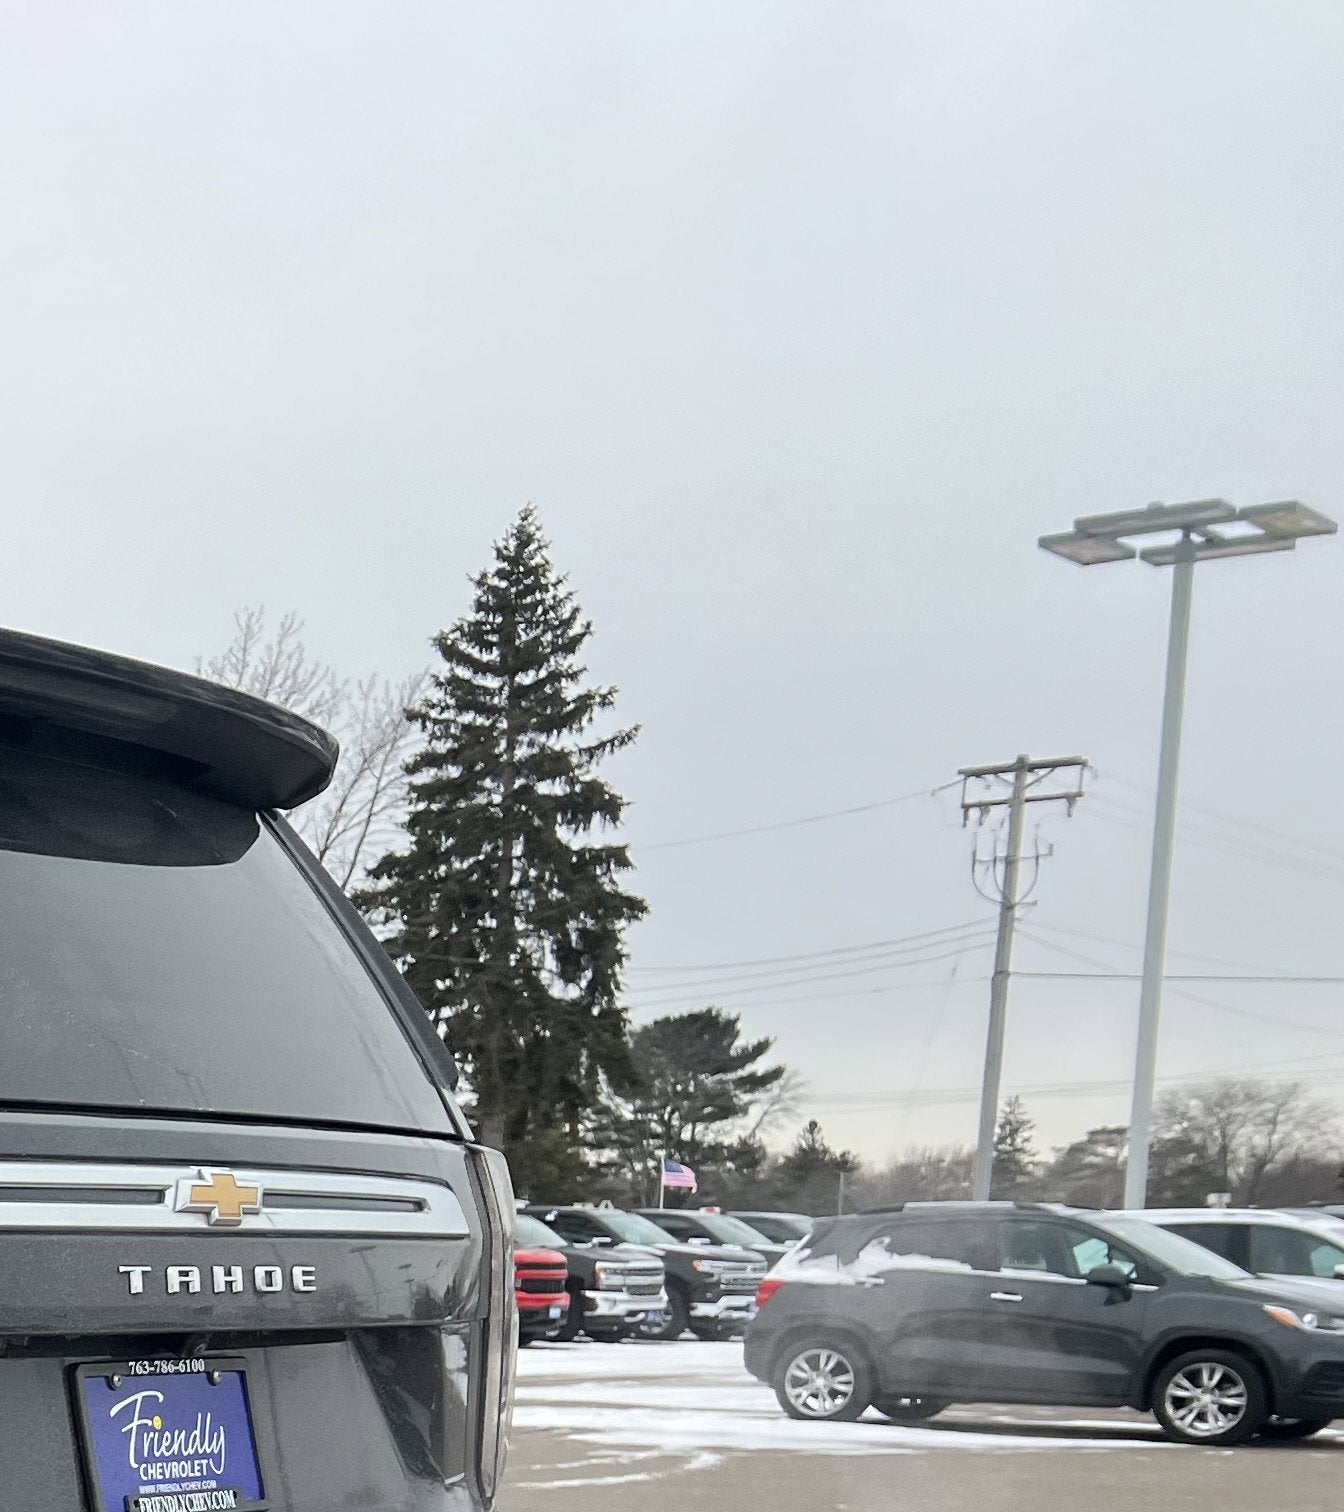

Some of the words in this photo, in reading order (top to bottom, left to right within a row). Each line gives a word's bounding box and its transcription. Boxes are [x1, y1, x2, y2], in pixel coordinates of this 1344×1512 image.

[118, 1265, 317, 1294] TAHOE
[128, 1358, 205, 1375] 763-786-6100
[109, 1390, 225, 1475] Friendly
[139, 1459, 209, 1481] CHEVROLET
